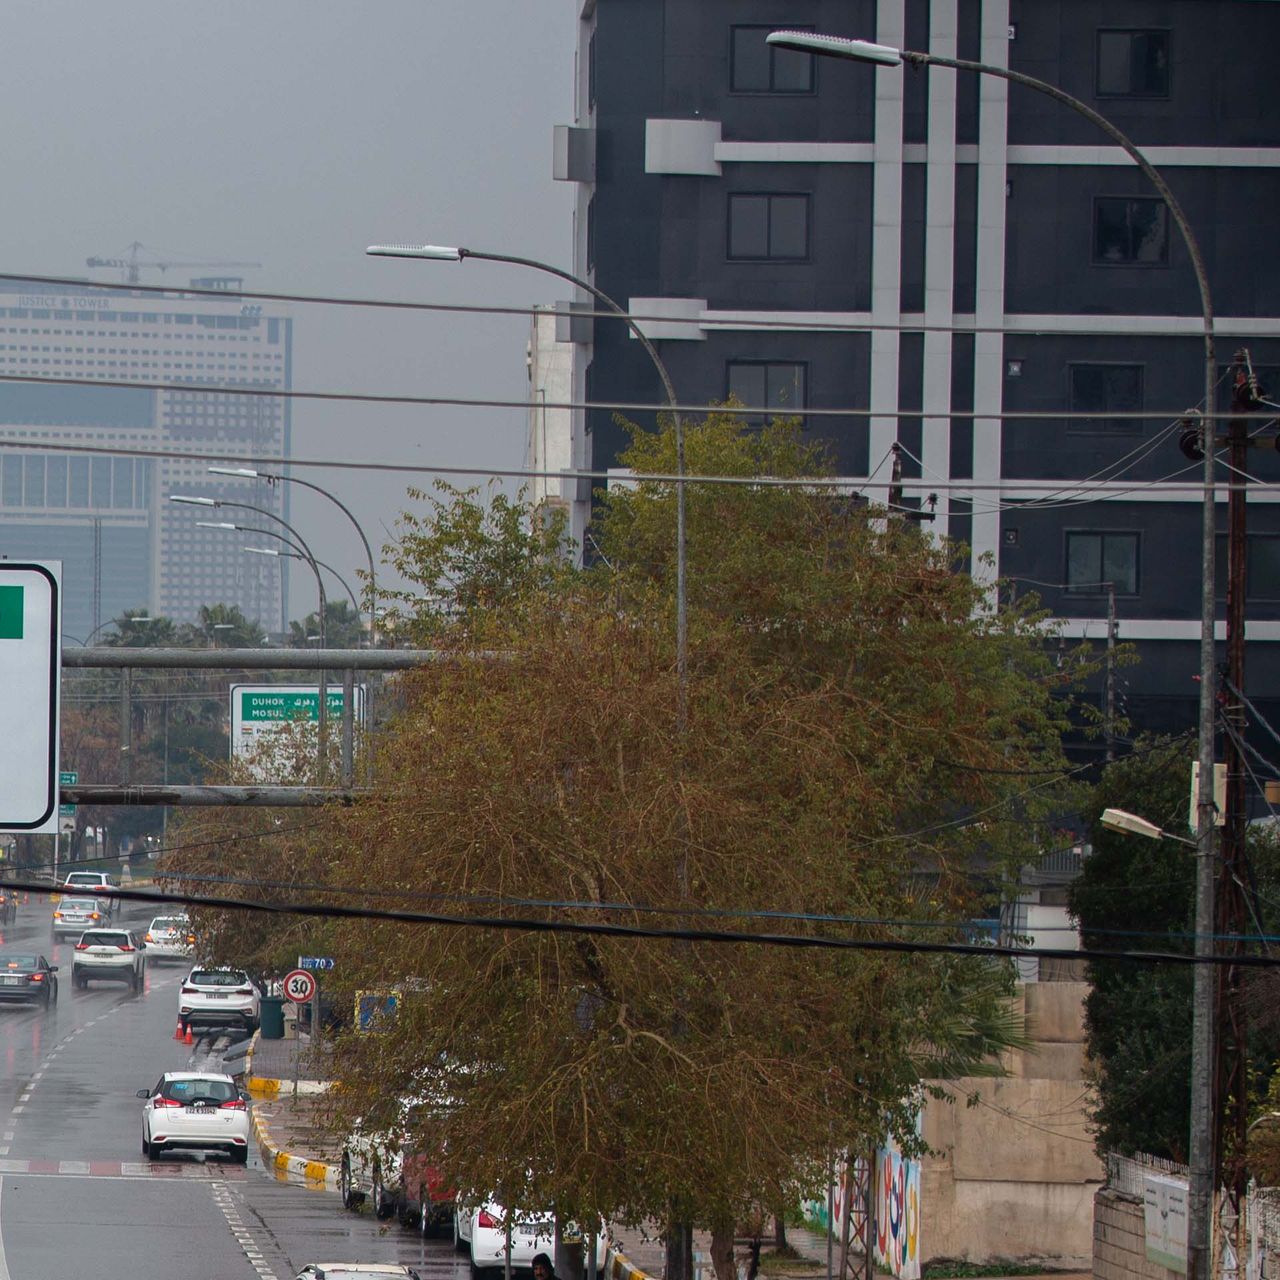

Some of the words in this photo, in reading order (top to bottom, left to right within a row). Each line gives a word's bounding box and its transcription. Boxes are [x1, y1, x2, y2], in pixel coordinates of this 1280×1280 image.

[72, 296, 111, 310] TOWER
[251, 697, 285, 706] DUHOK
[251, 709, 285, 718] MOSUL
[291, 978, 308, 994] 30
